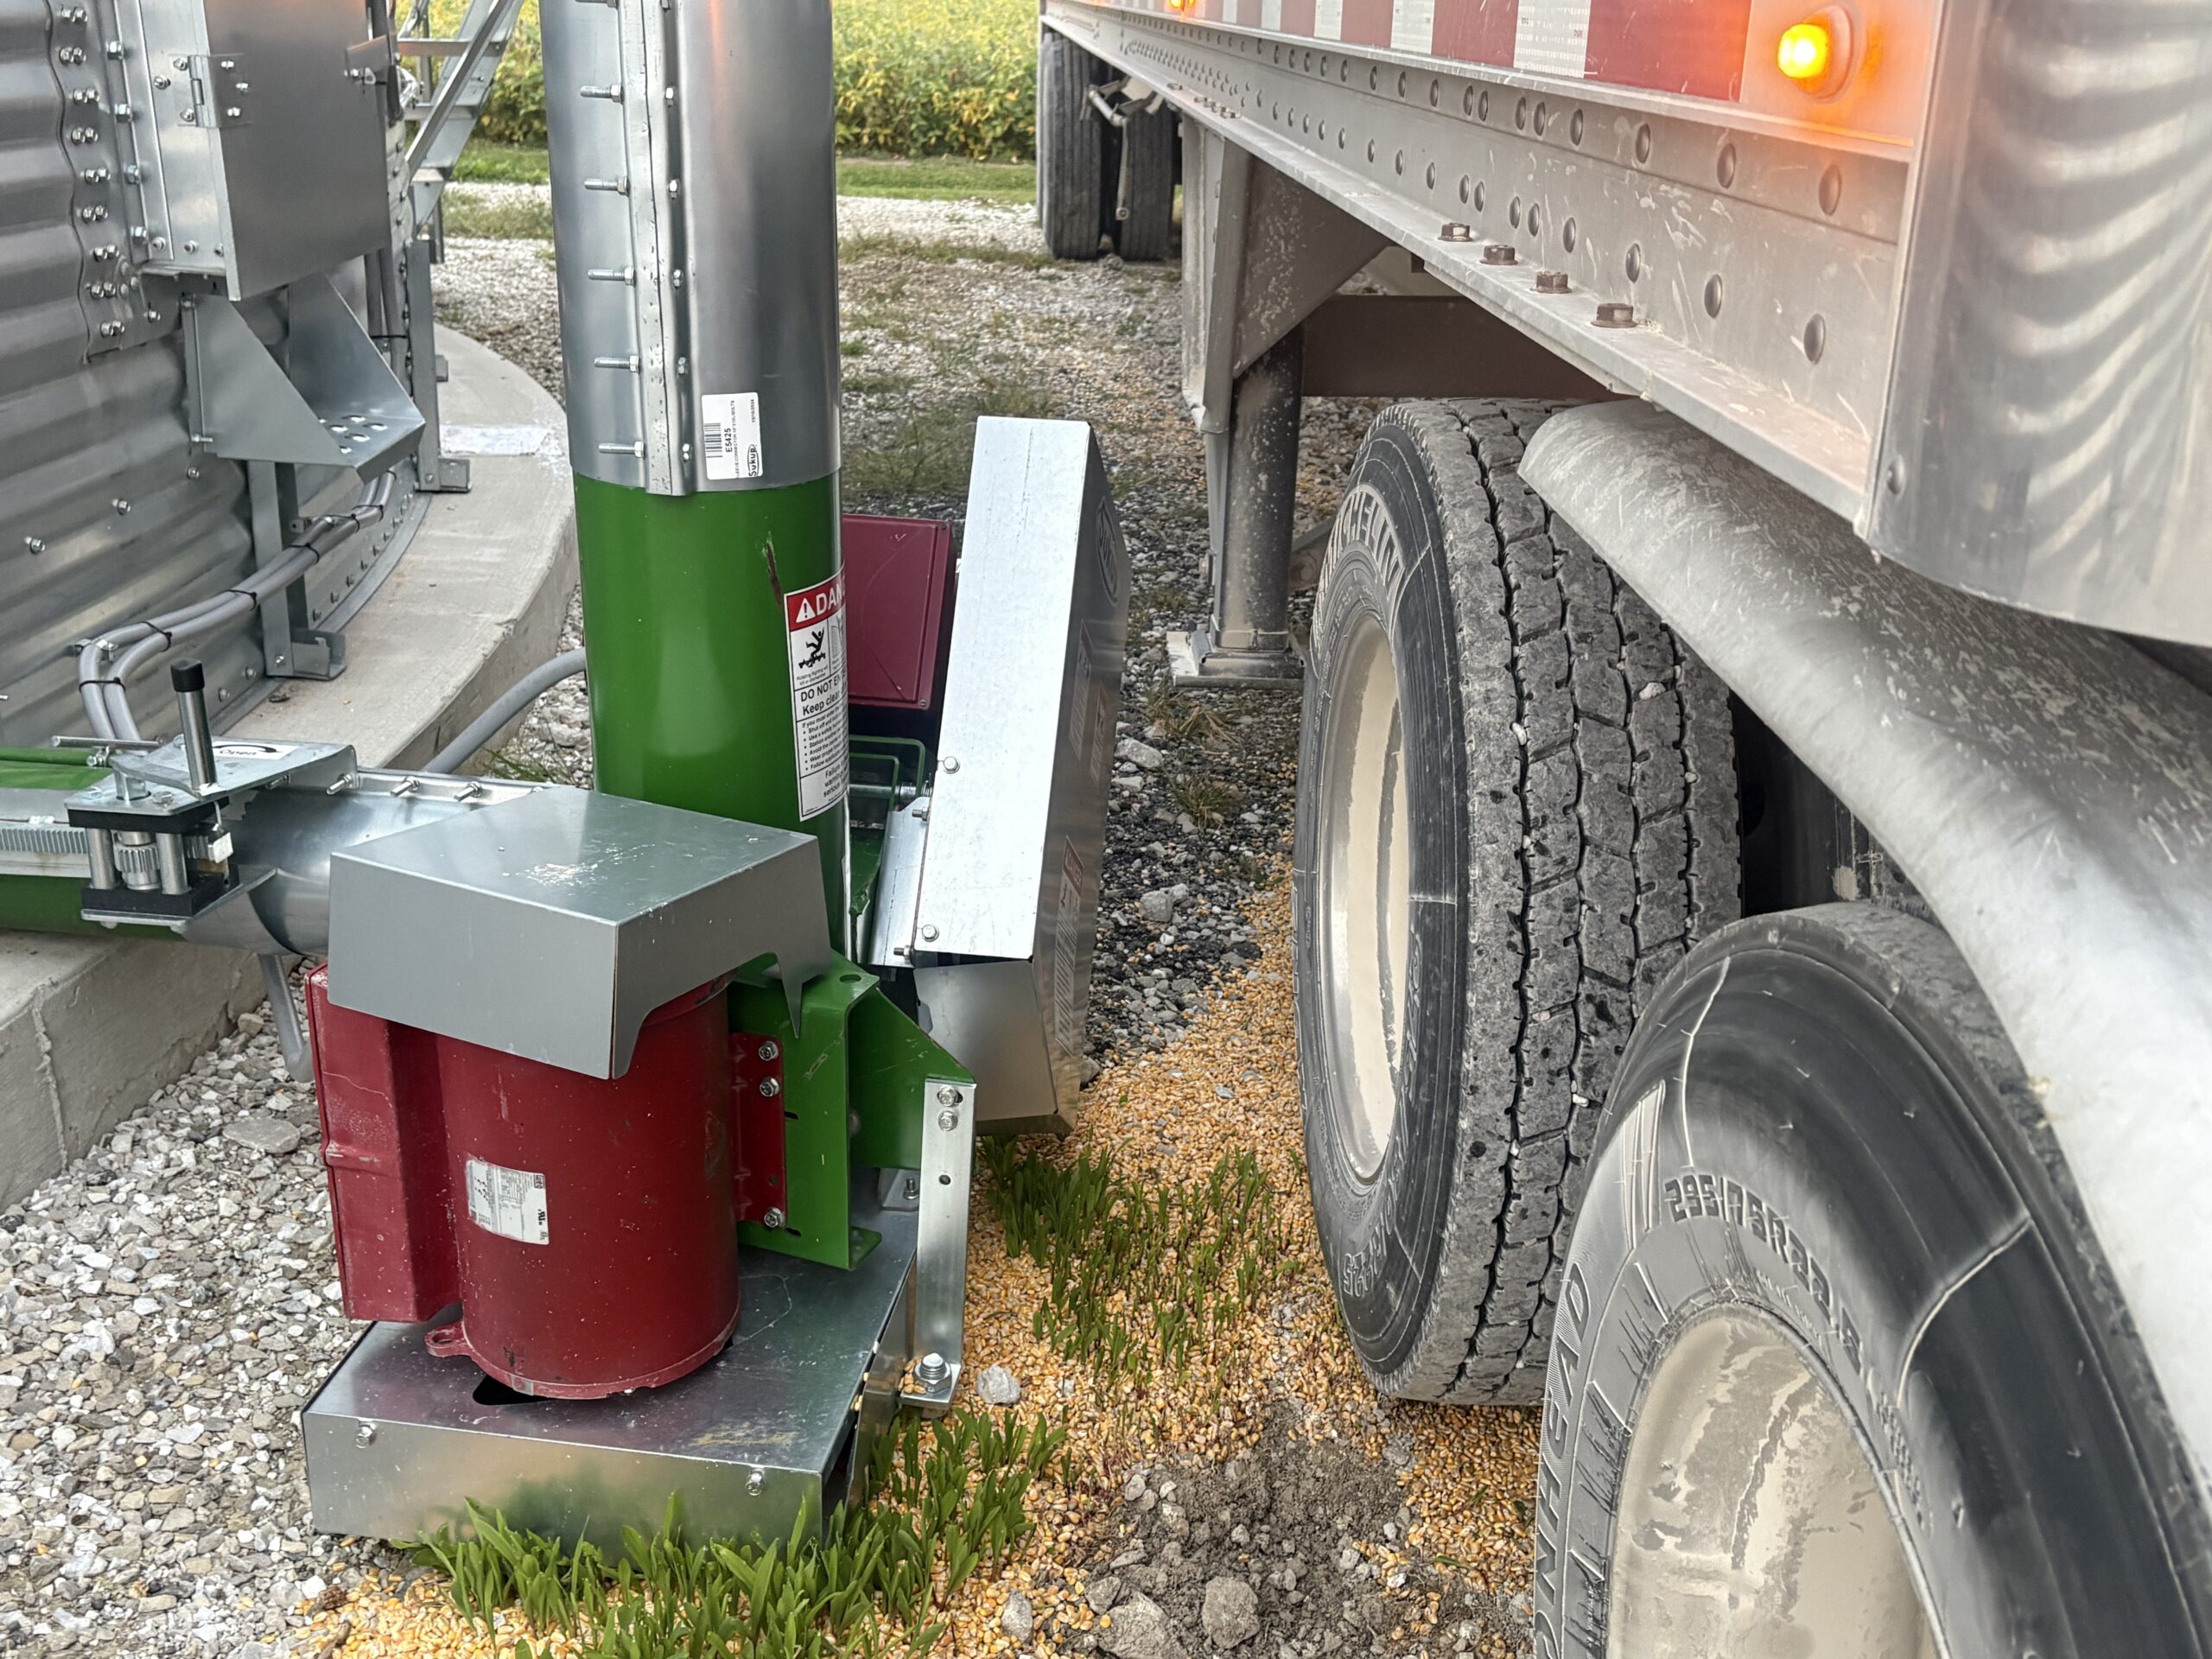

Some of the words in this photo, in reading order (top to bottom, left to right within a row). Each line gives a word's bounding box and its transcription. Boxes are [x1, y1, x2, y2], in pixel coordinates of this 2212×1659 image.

[724, 428, 733, 453] E5425
[748, 447, 758, 477] Sukup
[800, 689, 815, 702] DO
[817, 678, 832, 696] NOT
[802, 701, 824, 716] Keep
[826, 690, 841, 705] clear
[808, 733, 818, 741] Use
[1663, 1173, 1864, 1376] 295/75R22.5
